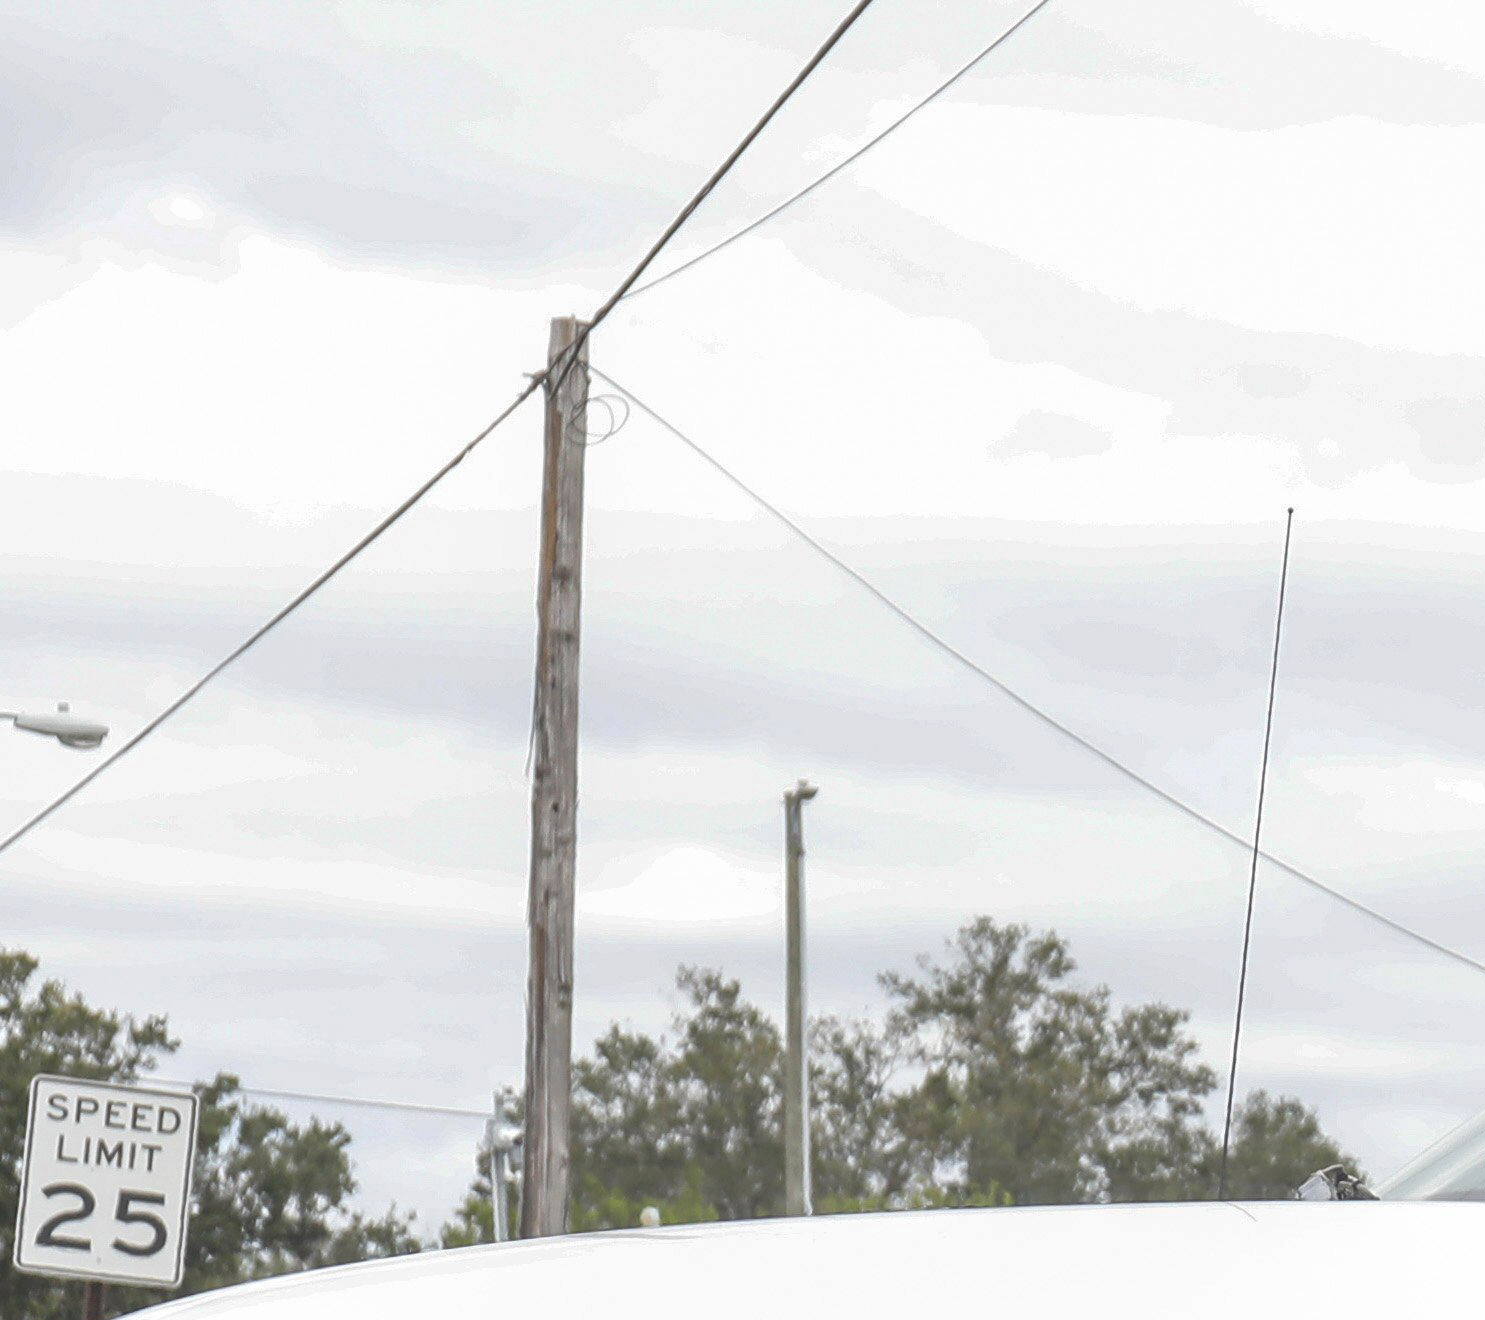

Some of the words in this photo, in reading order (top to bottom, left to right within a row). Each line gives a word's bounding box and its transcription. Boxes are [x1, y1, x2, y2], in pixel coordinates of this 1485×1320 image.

[46, 1094, 182, 1135] SPEED
[56, 1134, 163, 1172] LIMIT
[35, 1181, 168, 1257] 25
